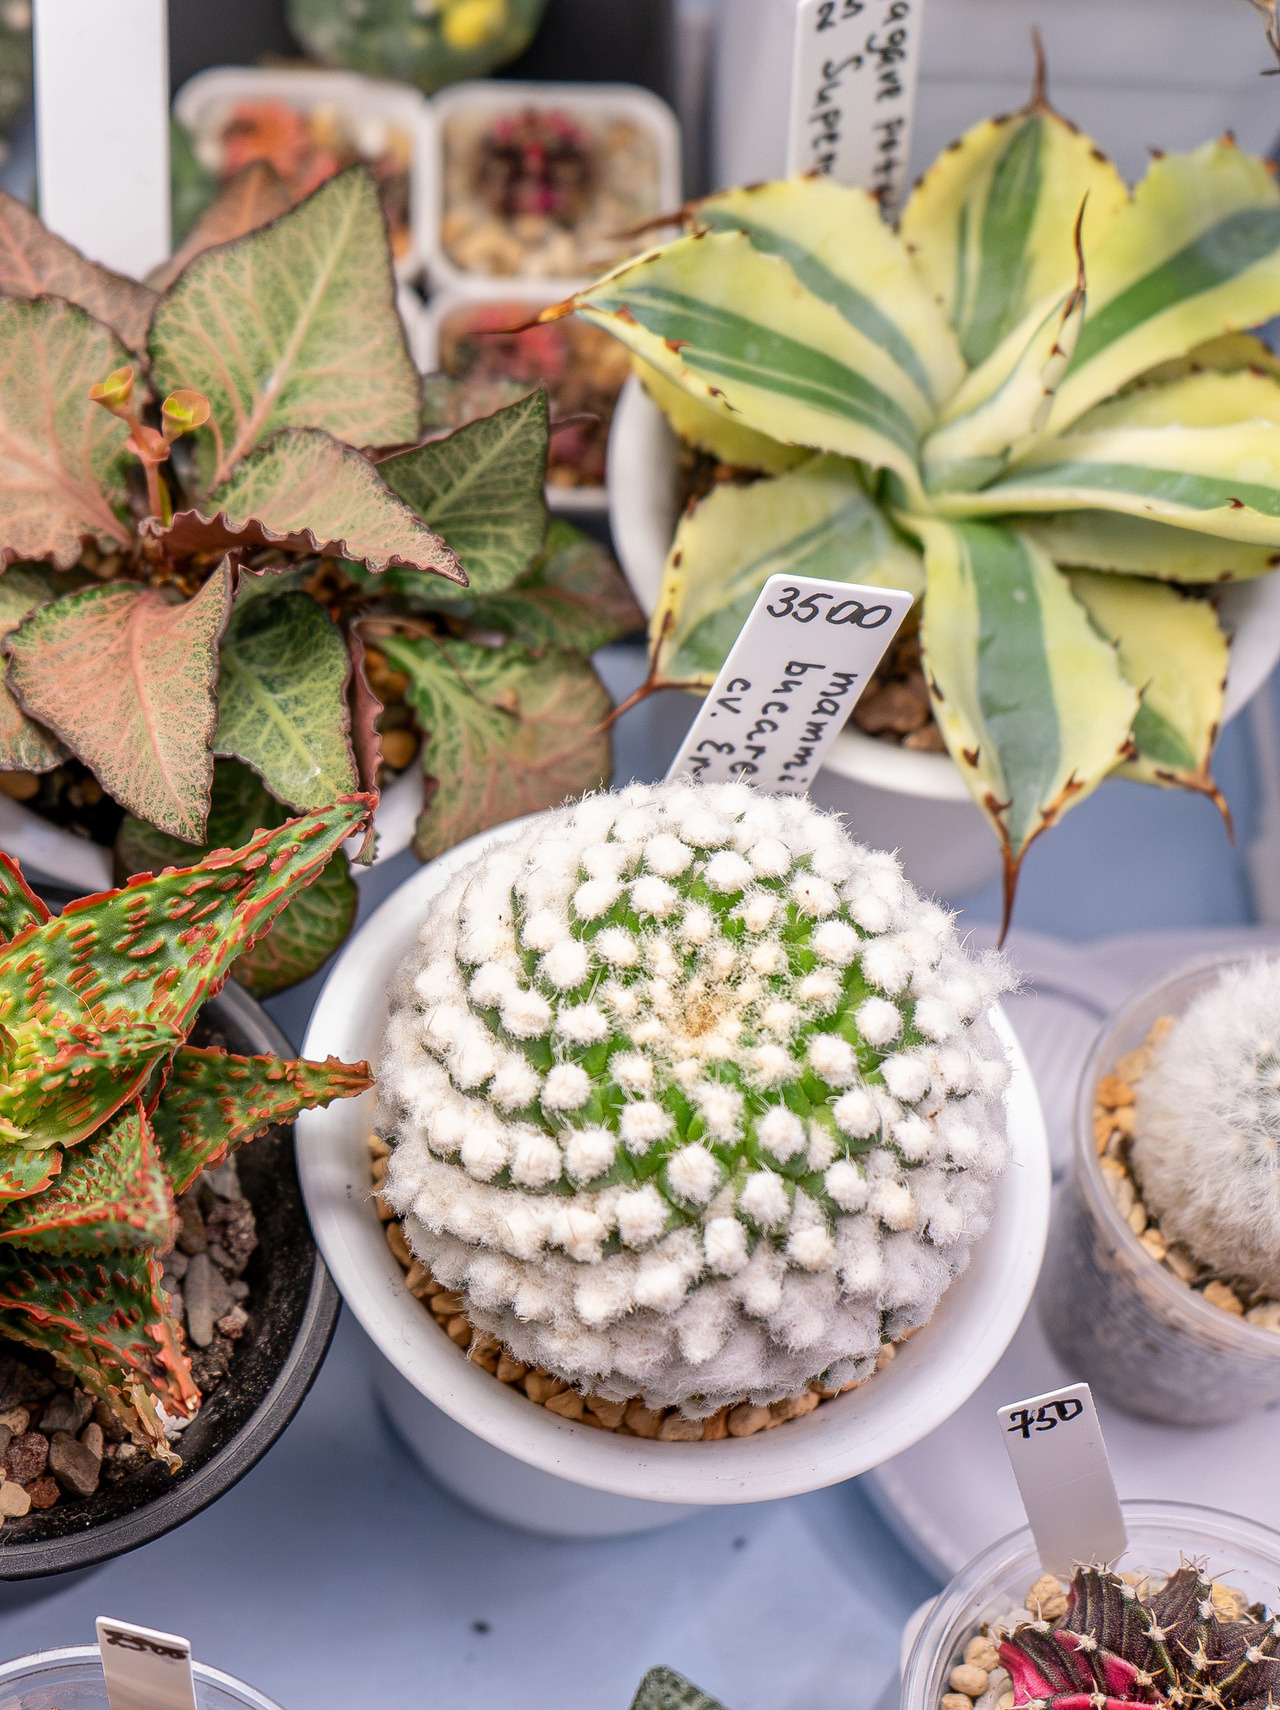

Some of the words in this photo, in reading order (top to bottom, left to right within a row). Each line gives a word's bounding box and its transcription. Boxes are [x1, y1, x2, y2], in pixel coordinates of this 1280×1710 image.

[766, 586, 893, 630] 3500
[729, 660, 826, 782] bucare
[777, 671, 858, 786] mammi
[1007, 1398, 1084, 1439] 750
